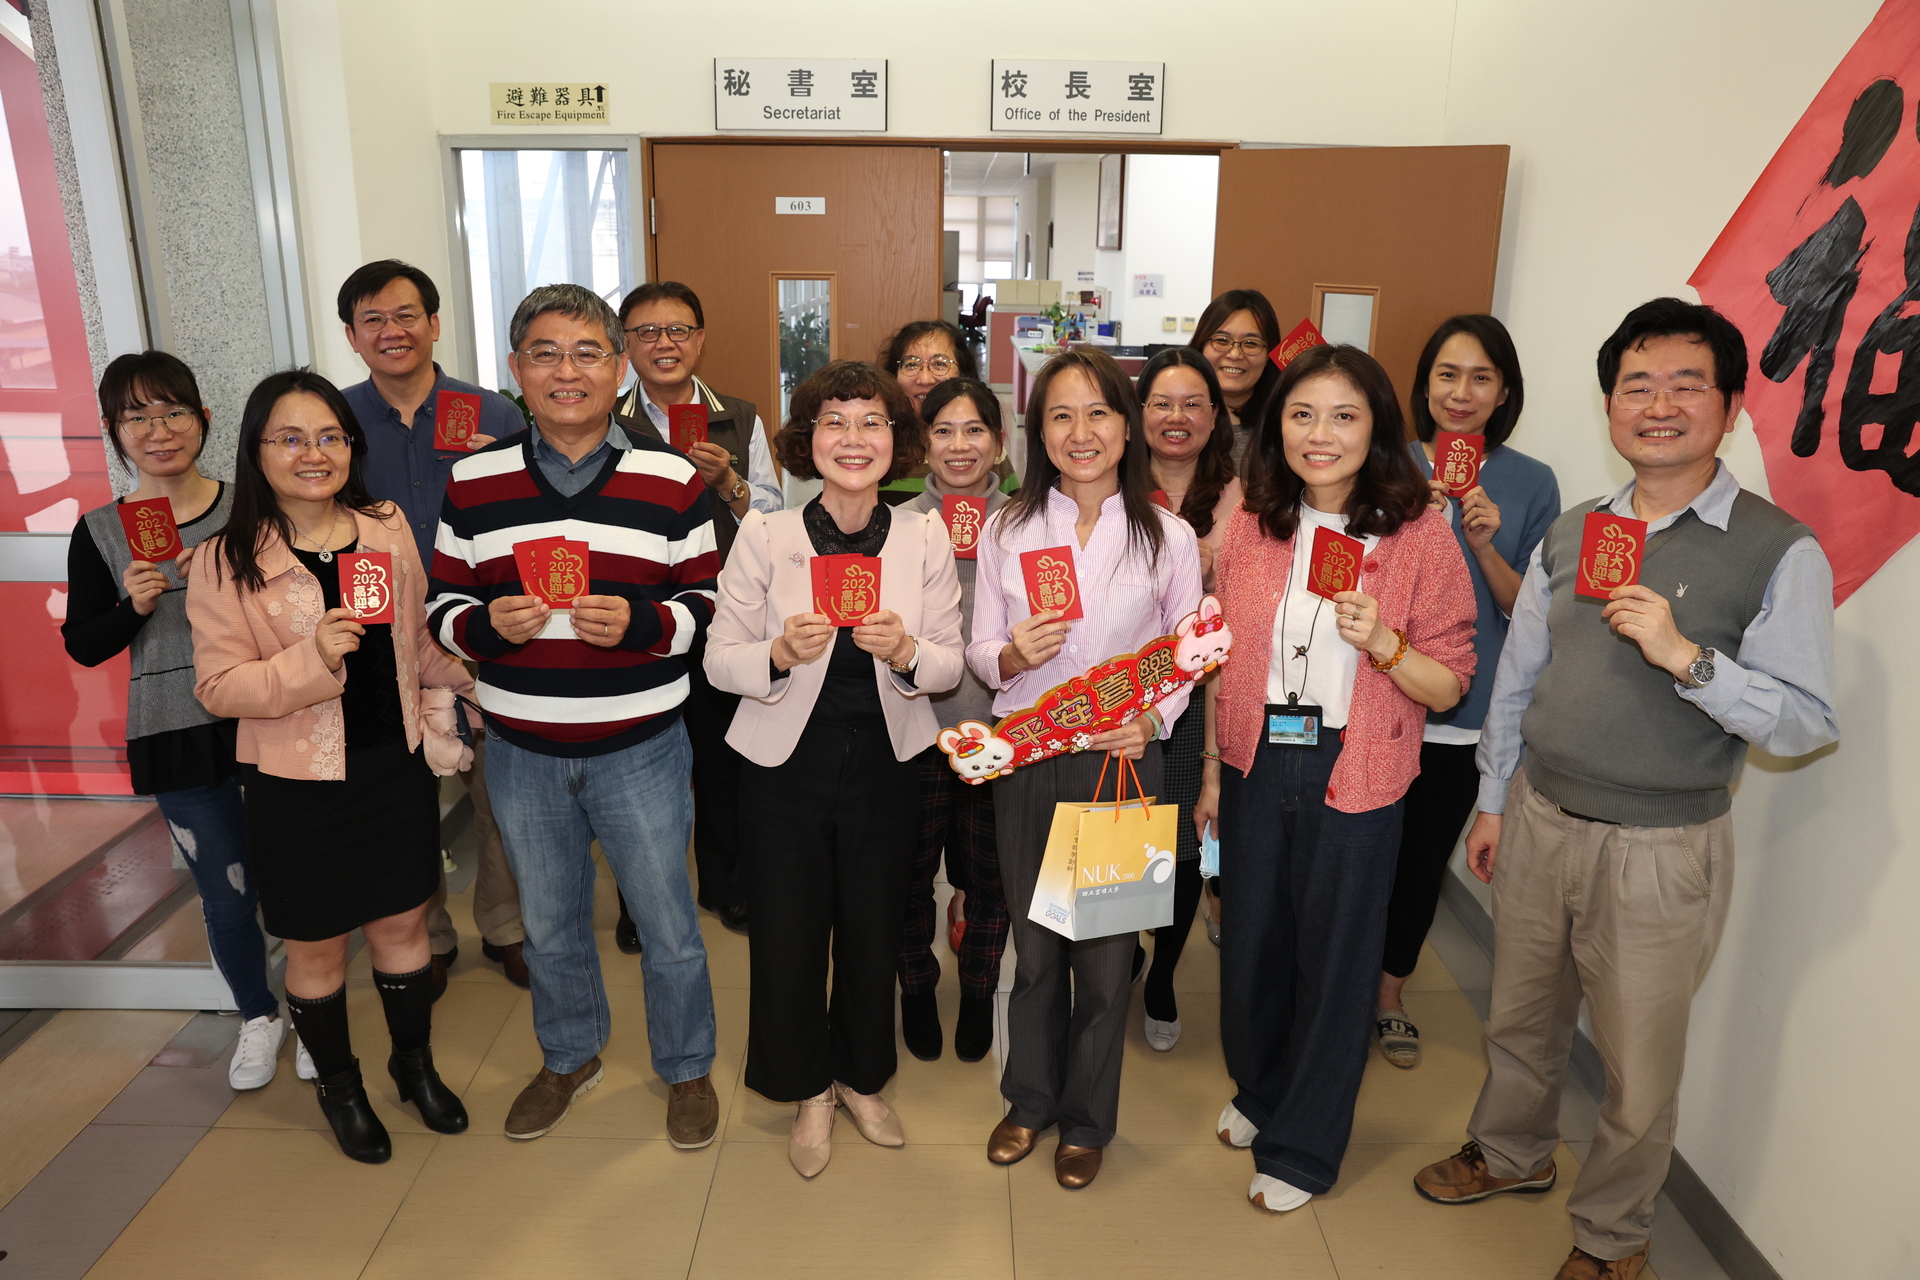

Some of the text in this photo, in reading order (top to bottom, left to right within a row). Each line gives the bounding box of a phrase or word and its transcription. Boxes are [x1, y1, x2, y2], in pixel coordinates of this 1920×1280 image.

[723, 69, 879, 98] 秘書室
[1001, 70, 1155, 101] 校長室
[505, 86, 596, 107] 避難器具
[497, 110, 605, 121] Fire Escape Equipment
[763, 105, 841, 120] Secretariat
[1005, 107, 1150, 123] Office of the President
[790, 200, 811, 211] 603
[1005, 646, 1174, 748] 平安喜樂
[1082, 862, 1122, 885] NUK
[1045, 910, 1067, 925] GOALS
